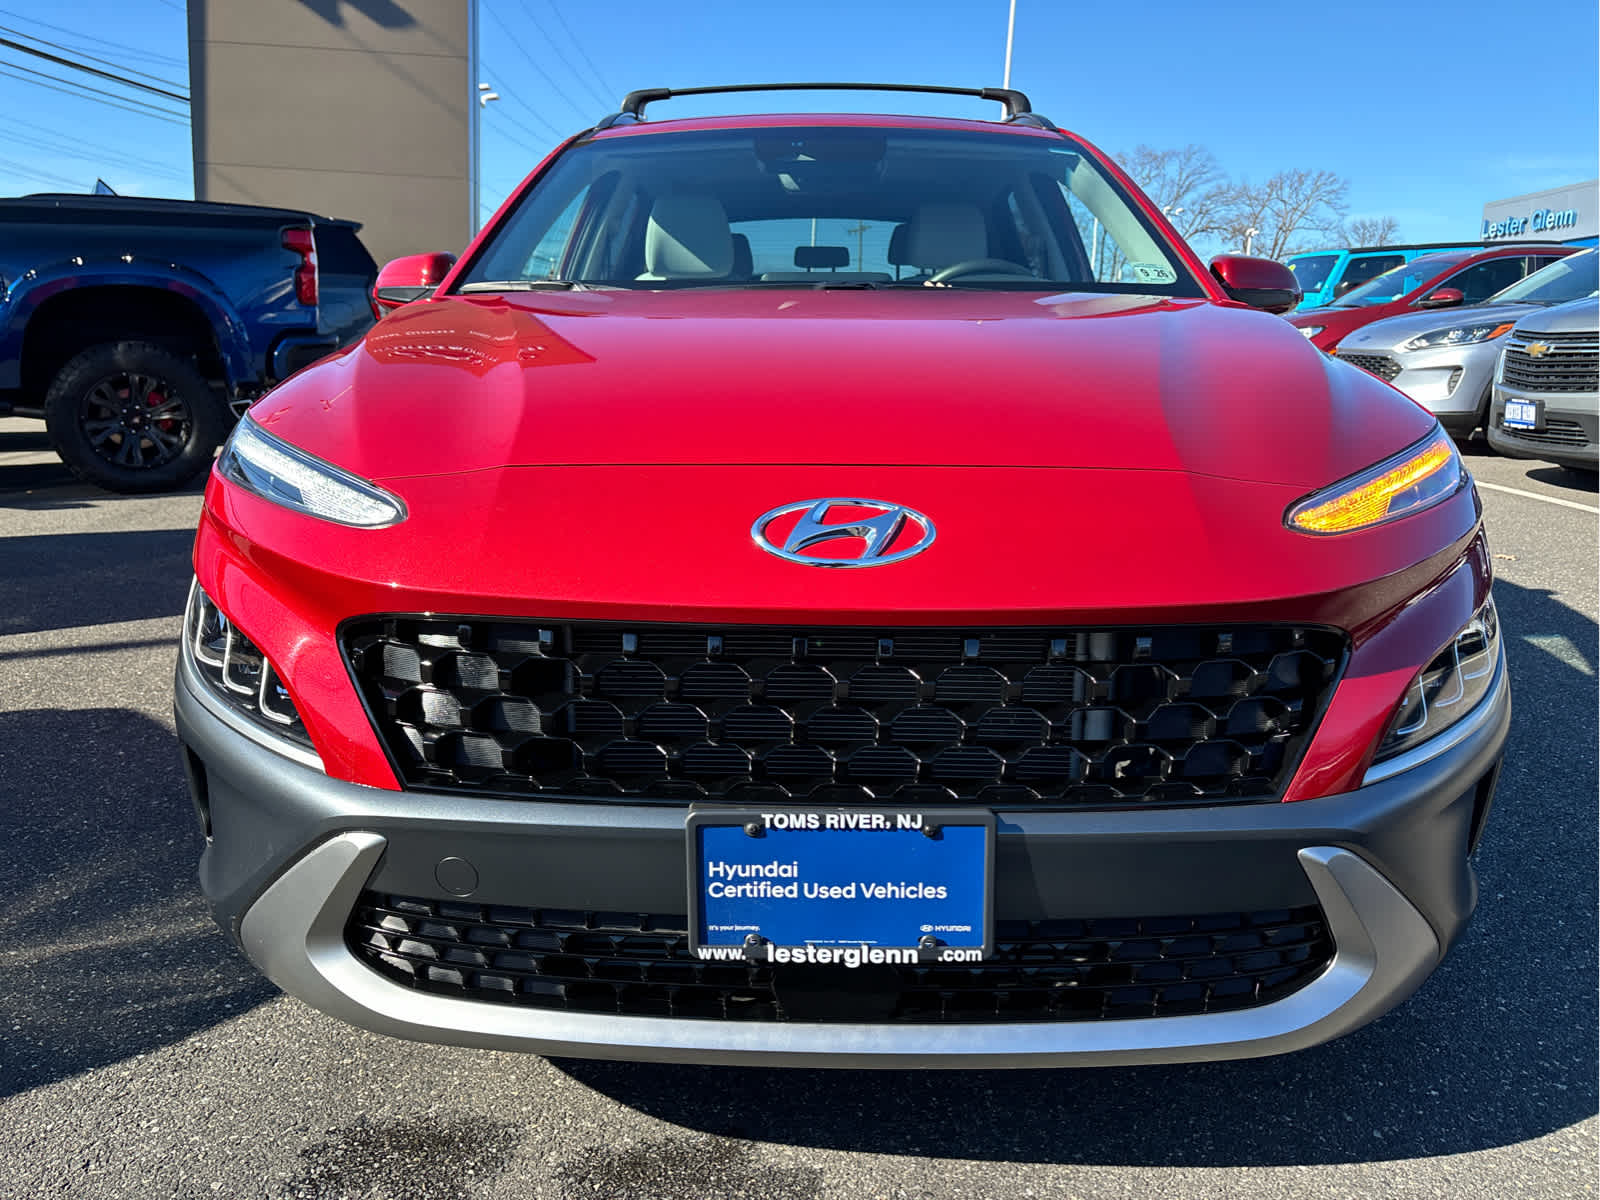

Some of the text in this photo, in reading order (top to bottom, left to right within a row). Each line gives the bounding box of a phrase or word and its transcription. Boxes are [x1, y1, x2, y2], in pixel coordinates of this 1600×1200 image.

[1481, 208, 1577, 239] Lester Glenn
[761, 813, 923, 830] TOMS RIVER, NJ
[708, 861, 798, 880] Hyundai
[708, 881, 948, 899] Certified Used Vehicles
[934, 924, 972, 932] HYUNDAI
[697, 944, 983, 968] www. lesterglenn .com
